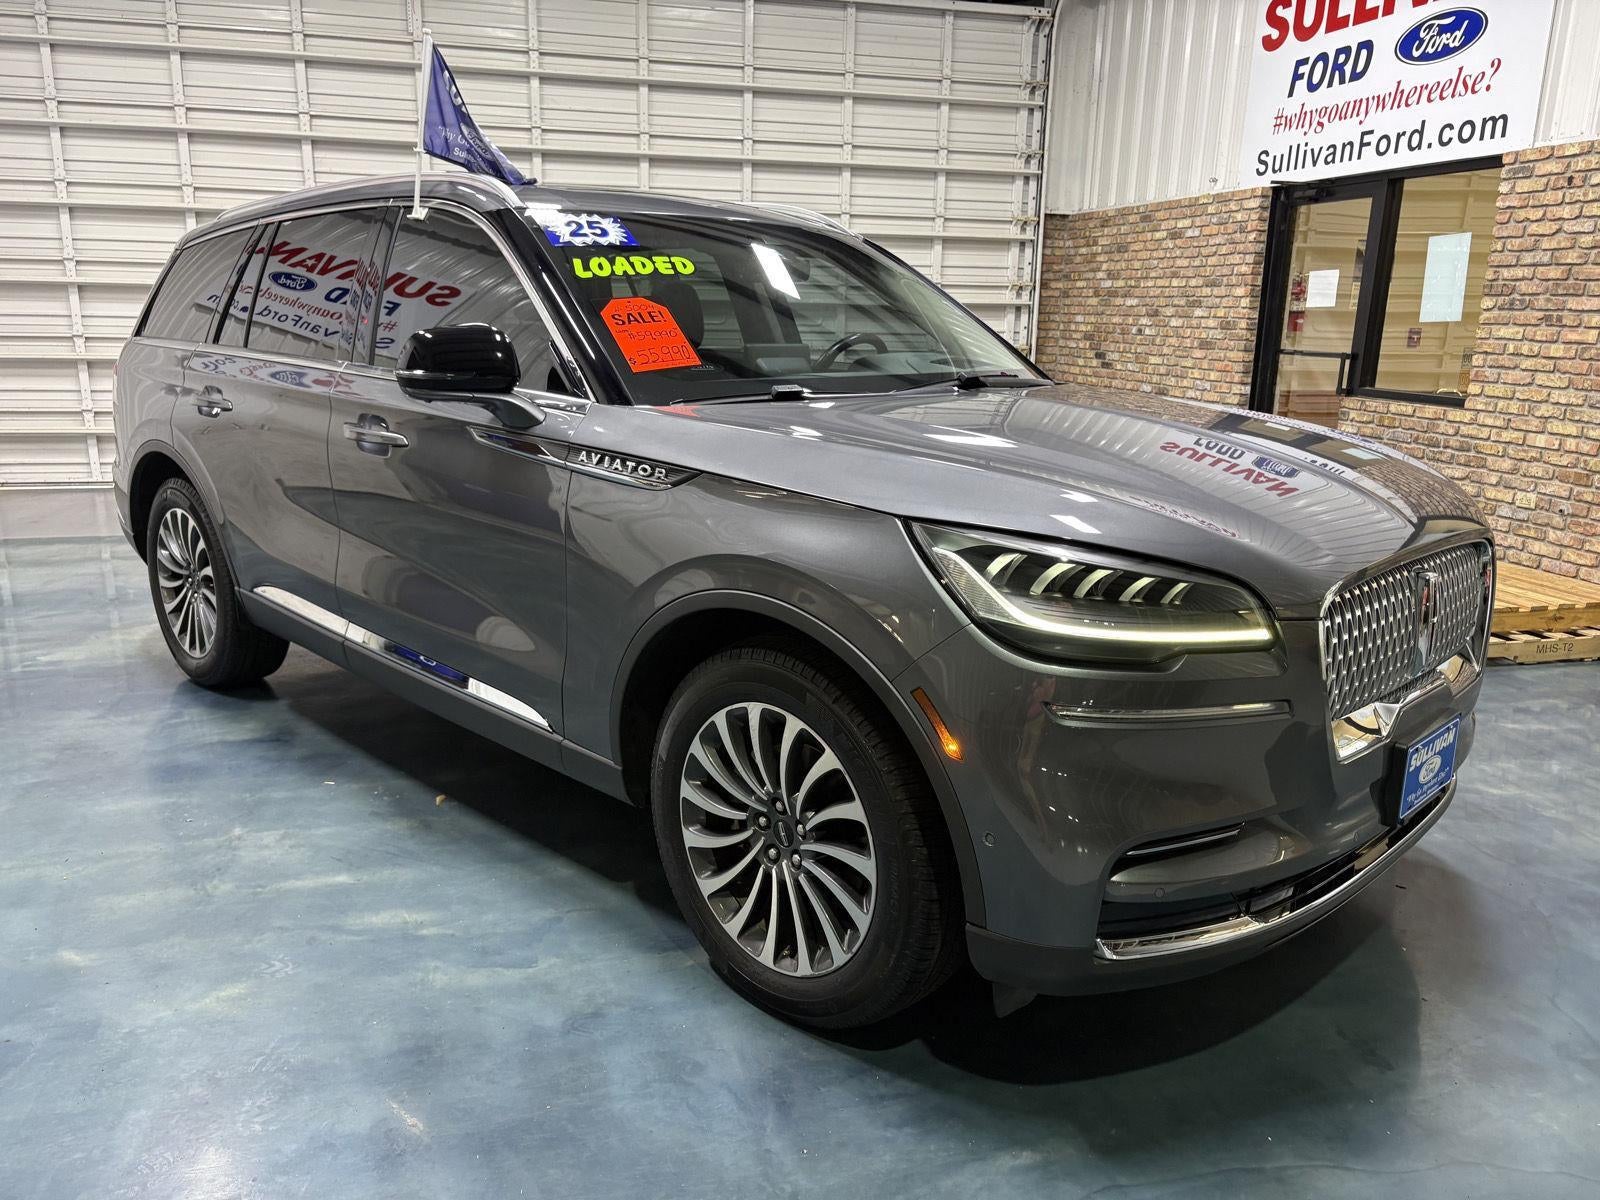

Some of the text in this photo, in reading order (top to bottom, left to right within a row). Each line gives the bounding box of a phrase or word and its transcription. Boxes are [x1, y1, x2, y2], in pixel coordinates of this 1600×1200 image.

[1411, 16, 1469, 58] Ford
[1288, 39, 1374, 98] FORD
[1272, 58, 1502, 136] #whygoanywhereelse?
[1255, 112, 1509, 177] SullivanFord.com
[565, 220, 609, 238] 25
[572, 256, 695, 279] LOADED
[612, 311, 668, 327] SALE!
[578, 450, 668, 481] AVIATOR
[1536, 642, 1574, 655] MHS-T2
[1409, 727, 1457, 773] SULLIVAN
